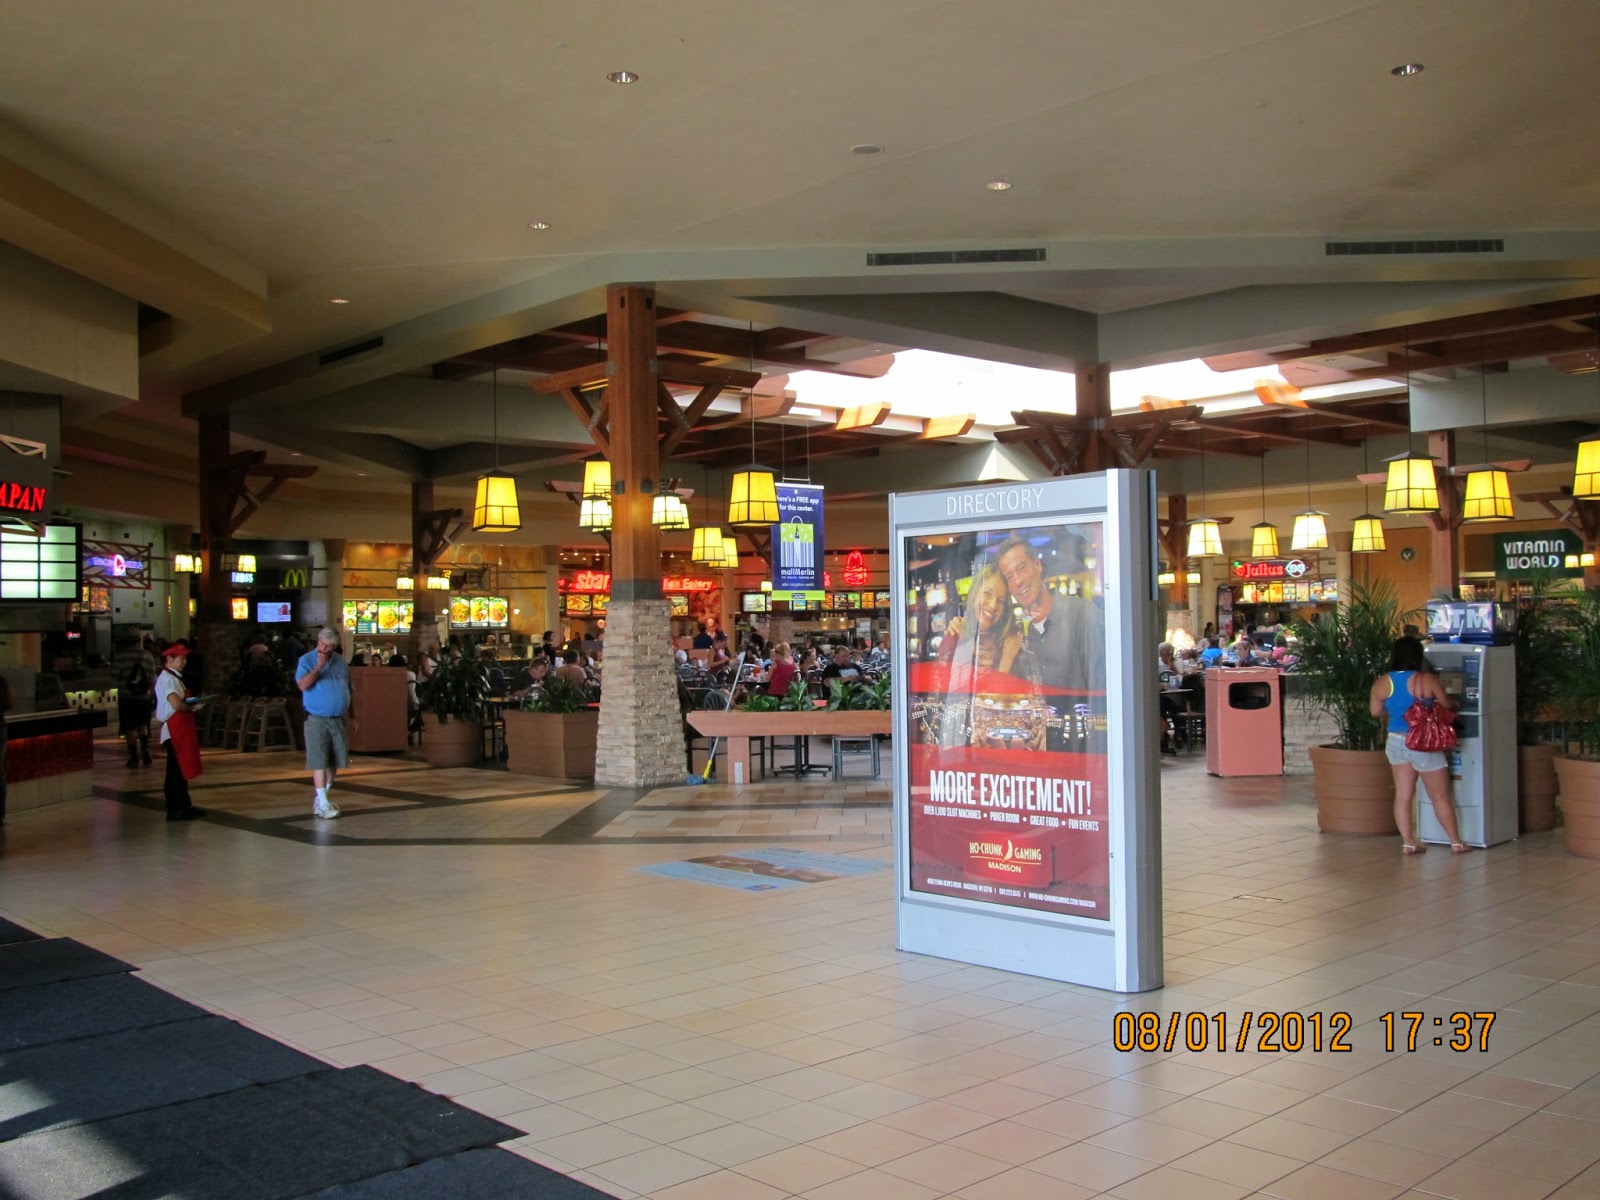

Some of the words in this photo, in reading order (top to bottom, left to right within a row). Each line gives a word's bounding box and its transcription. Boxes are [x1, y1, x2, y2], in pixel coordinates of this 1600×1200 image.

[0, 482, 46, 512] APAN
[777, 495, 791, 503] here's
[946, 487, 1044, 516] DIRECTORY
[1503, 540, 1565, 555] VITAMIN
[1244, 563, 1284, 578] Julius
[1506, 555, 1560, 570] WORLD
[576, 571, 611, 590] sbar
[1429, 608, 1488, 629] ATM
[930, 770, 976, 805] MORE
[980, 773, 1091, 815] EXCITEMENT!
[947, 807, 958, 817] SLOT
[958, 808, 981, 820] MACHINES
[990, 811, 1005, 822] POKER
[1006, 812, 1019, 823] ROOM
[1030, 815, 1045, 826] GREAT
[1046, 816, 1059, 827] FOOD
[1069, 819, 1078, 829] FUN
[1079, 820, 1099, 831] EVENTS
[969, 842, 1003, 856] HO-CHUNK
[1014, 847, 1042, 860] GAMING
[988, 861, 1022, 873] MADISON
